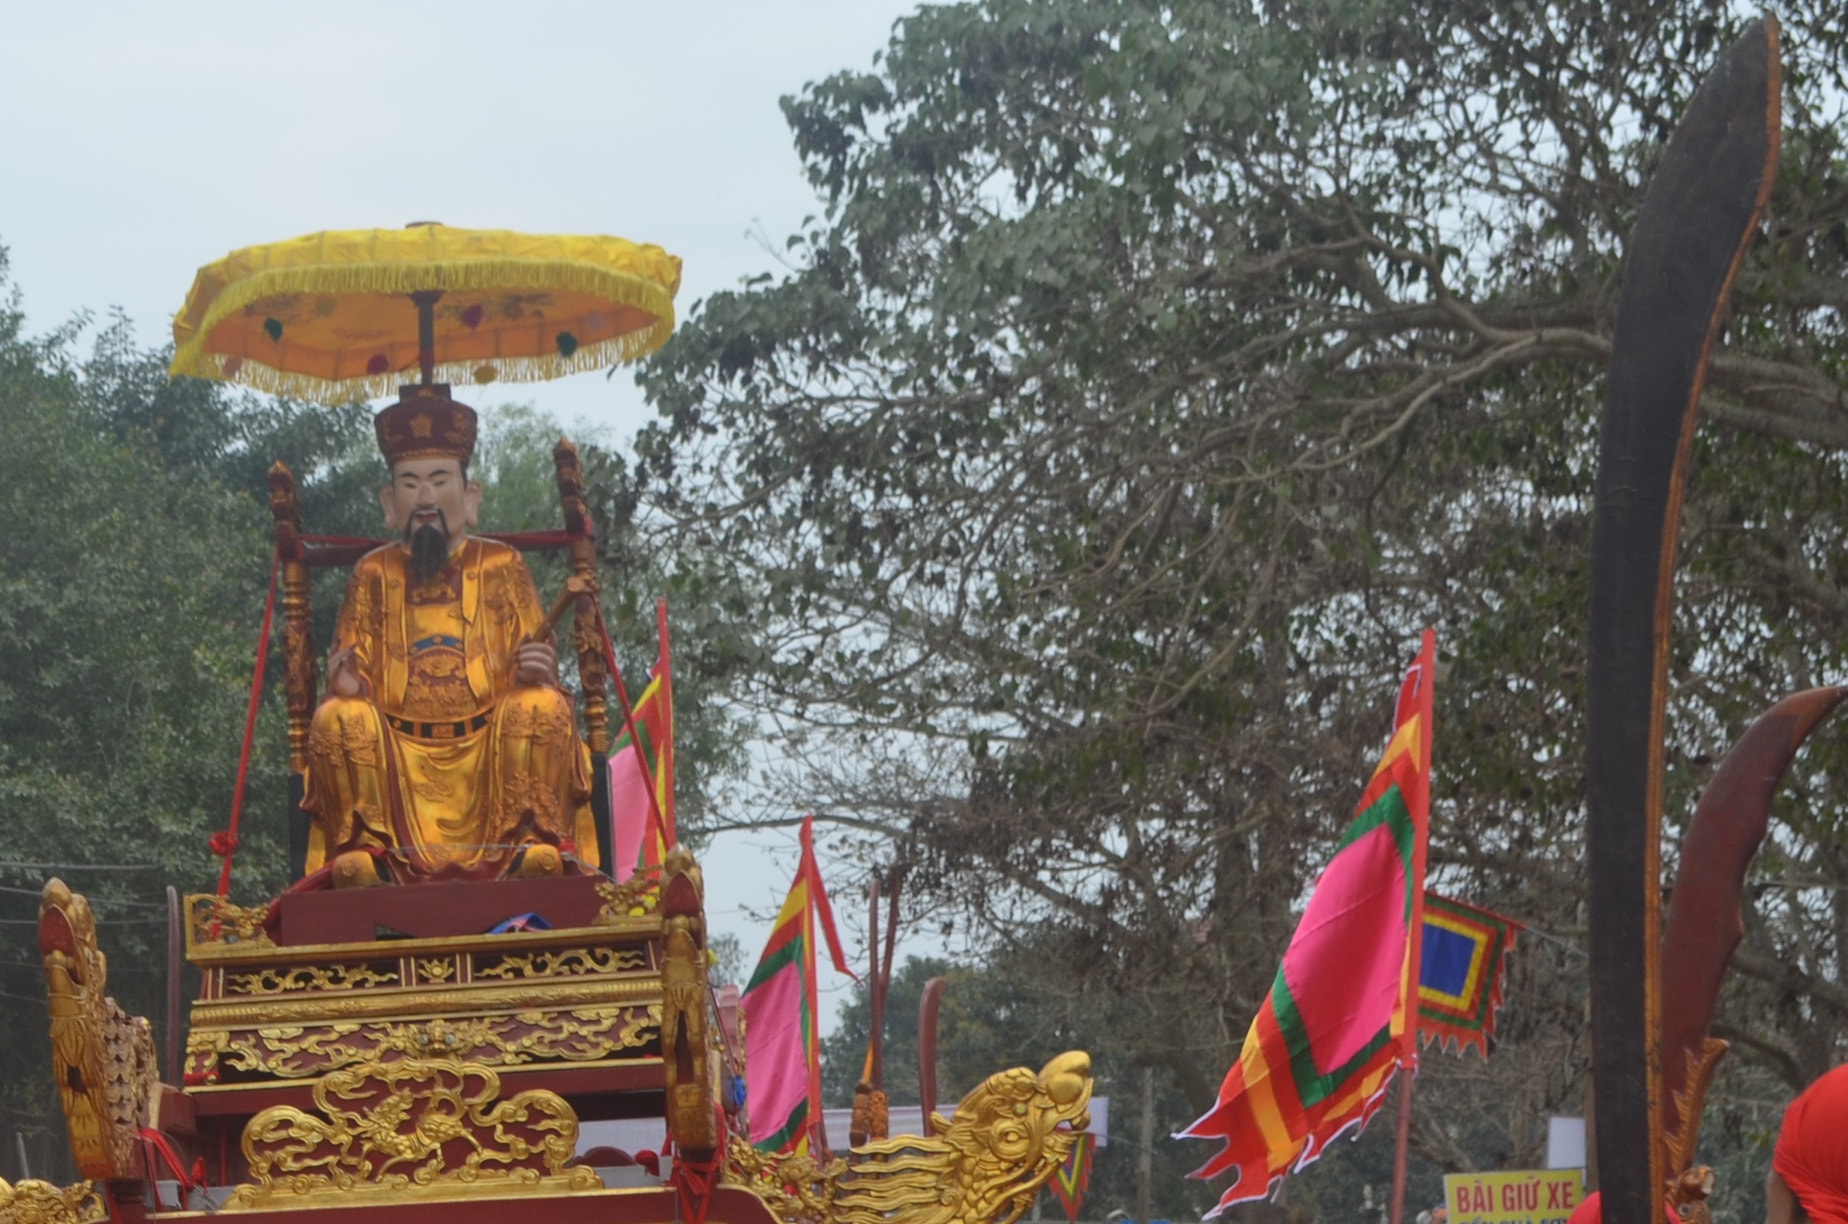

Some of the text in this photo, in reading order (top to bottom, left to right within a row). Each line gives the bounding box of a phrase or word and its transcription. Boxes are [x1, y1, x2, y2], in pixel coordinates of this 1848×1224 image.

[1456, 1175, 1574, 1213] BÃI GIỮ XE
